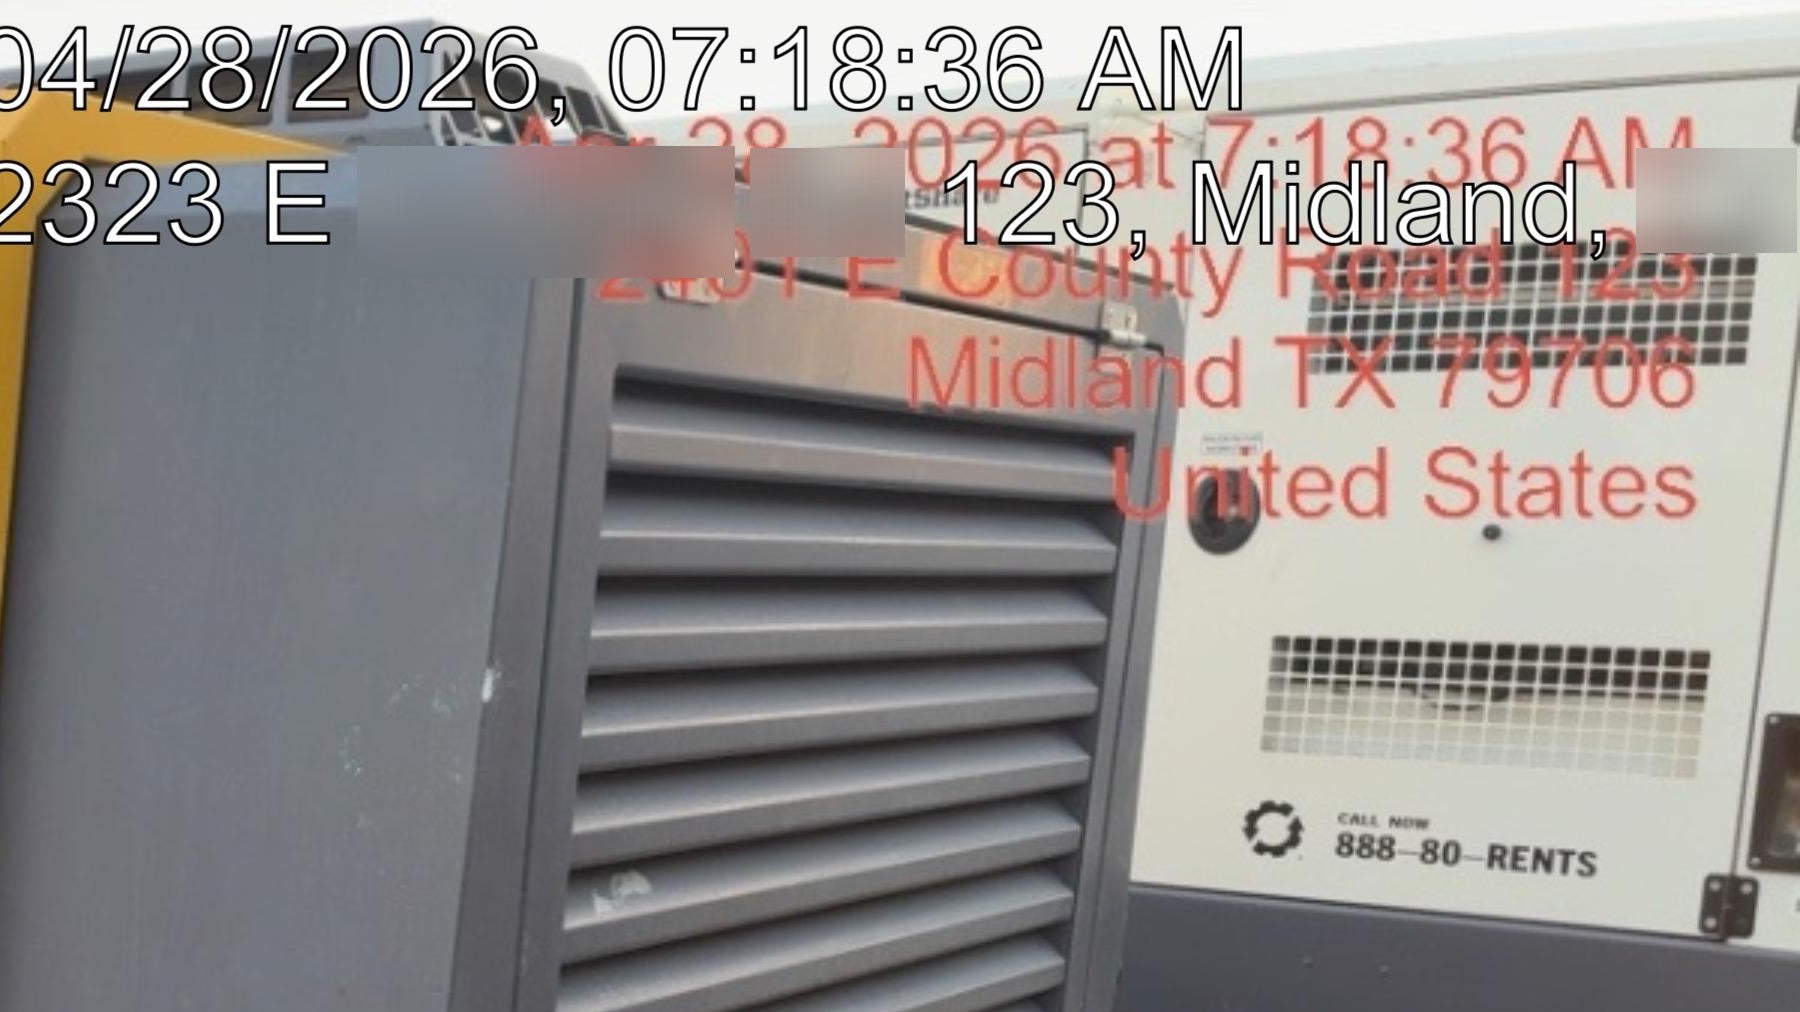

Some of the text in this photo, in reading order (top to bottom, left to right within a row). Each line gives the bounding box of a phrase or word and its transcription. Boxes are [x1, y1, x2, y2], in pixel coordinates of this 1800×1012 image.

[1337, 812, 1430, 830] CALL NOW
[1335, 831, 1598, 877] 888-80-RENTS
